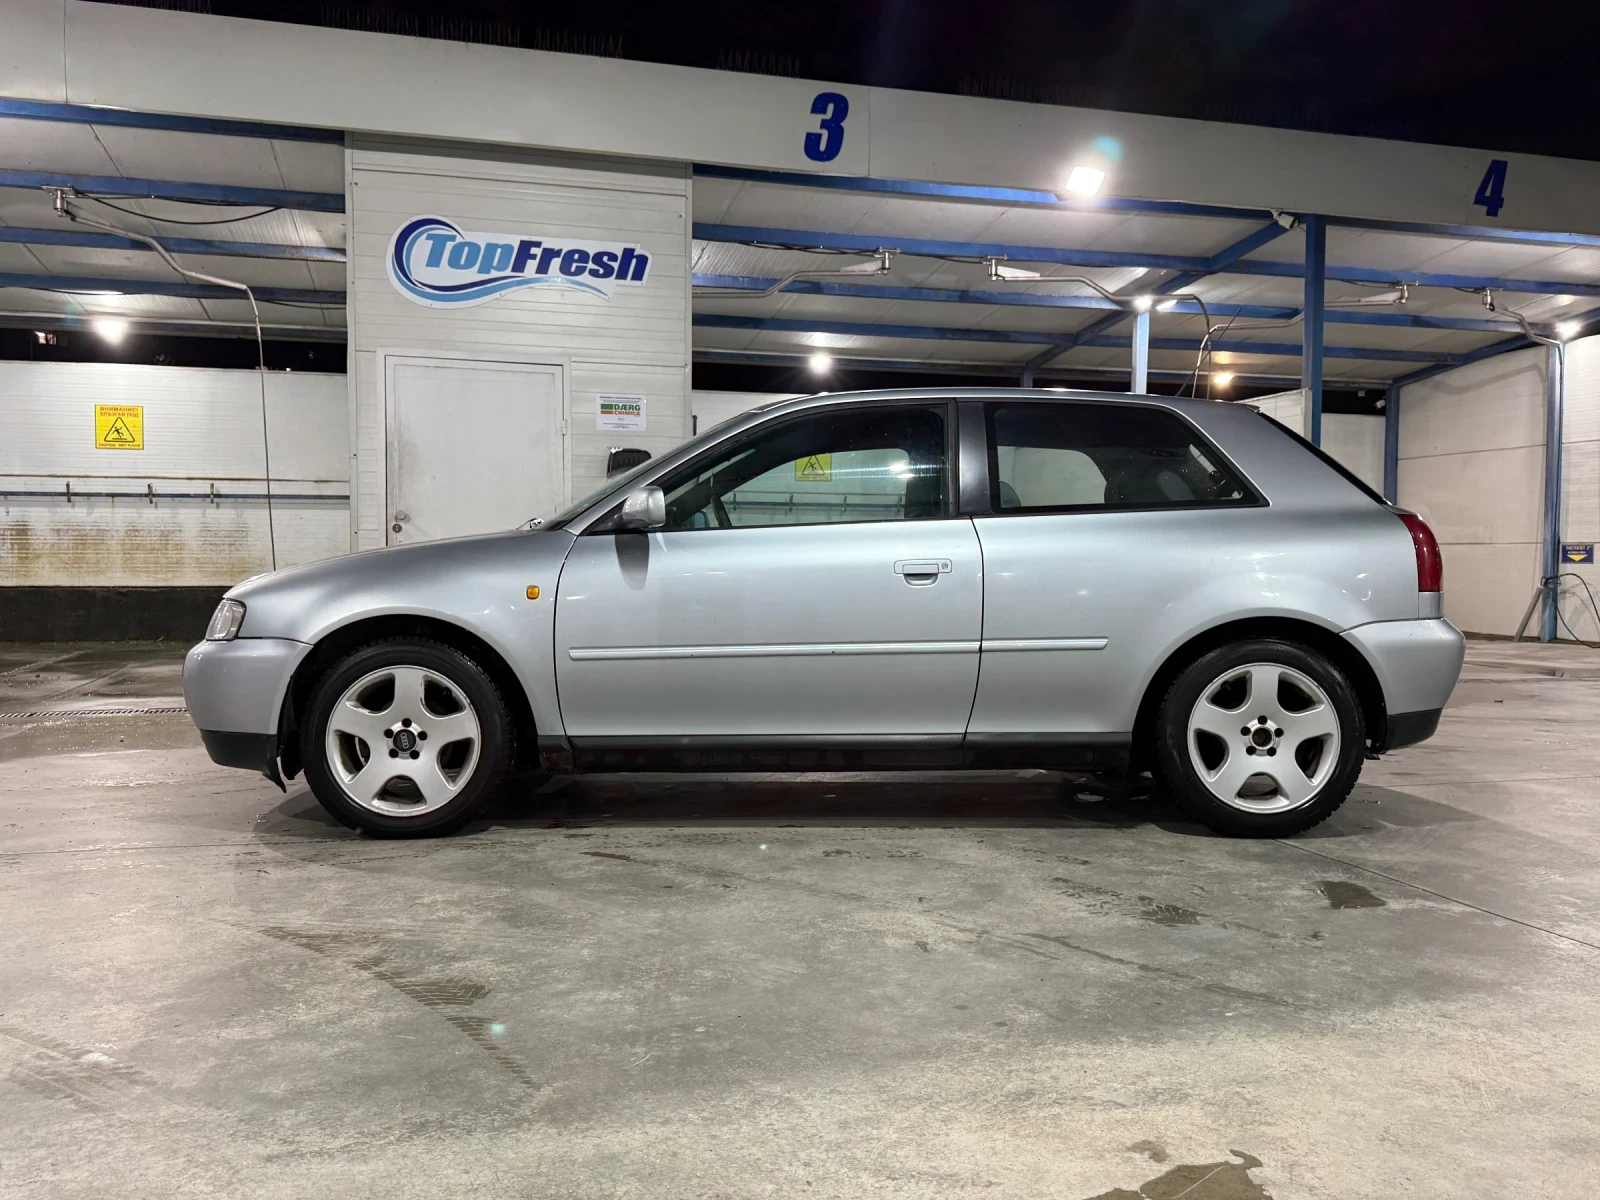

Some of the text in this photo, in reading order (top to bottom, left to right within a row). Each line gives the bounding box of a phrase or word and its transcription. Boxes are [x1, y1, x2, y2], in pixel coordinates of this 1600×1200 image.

[804, 92, 849, 162] 3
[1473, 159, 1508, 217] 4
[425, 232, 649, 282] TopFresh
